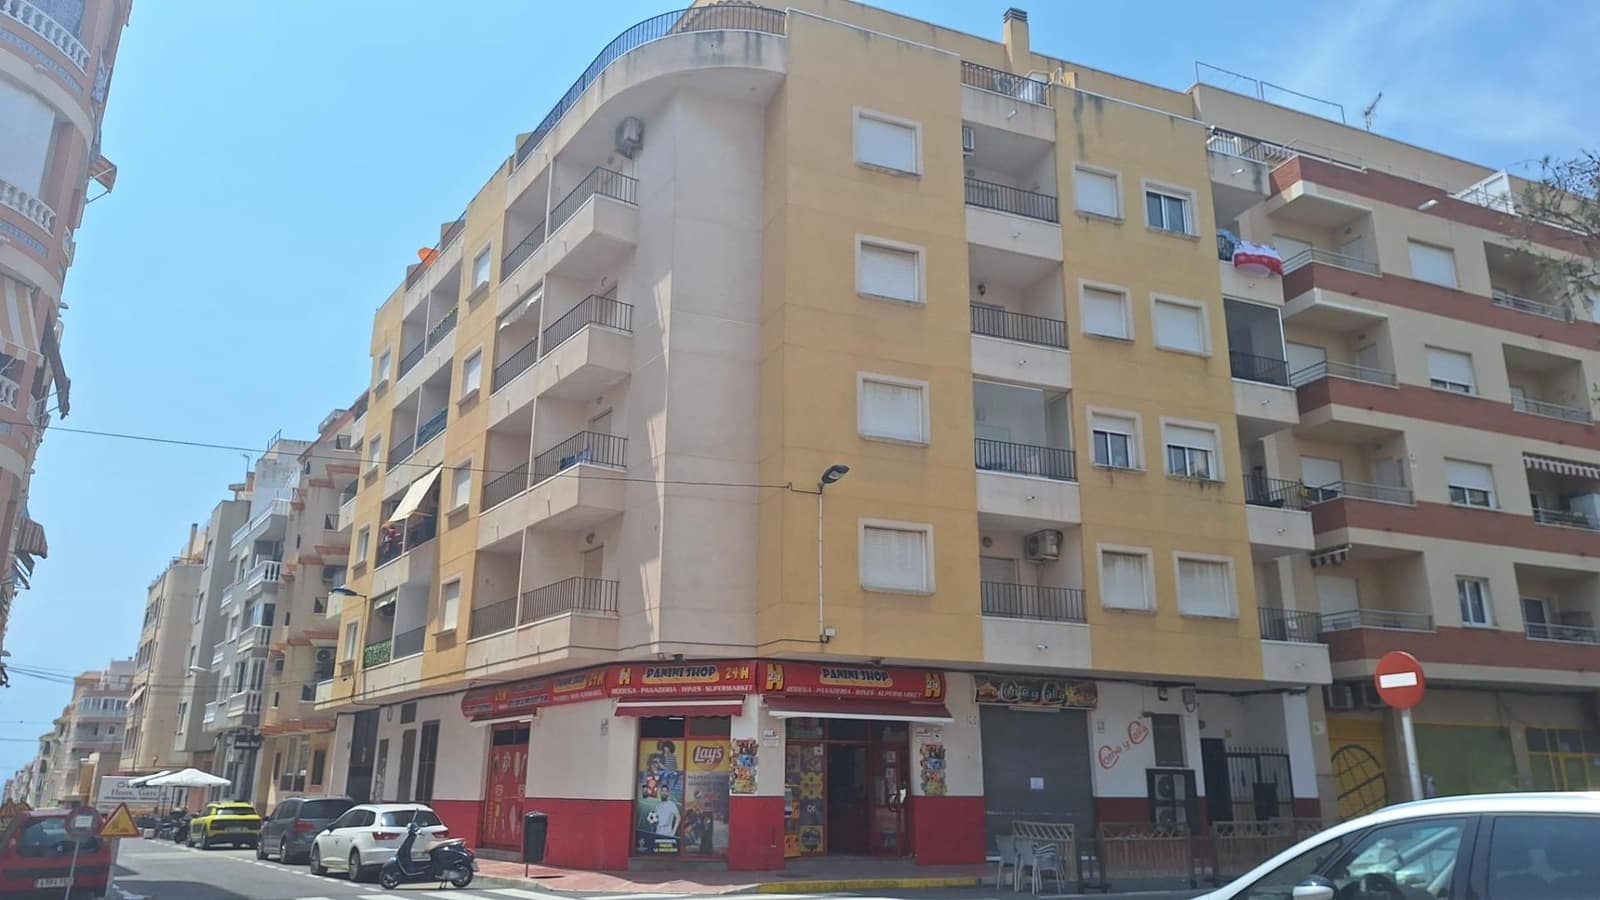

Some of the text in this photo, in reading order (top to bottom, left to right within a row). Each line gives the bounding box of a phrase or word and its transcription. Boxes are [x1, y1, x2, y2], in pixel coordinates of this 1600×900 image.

[646, 667, 682, 678] PANINI
[687, 666, 716, 677] SHOP
[823, 668, 888, 682] PANINI SHOP
[705, 684, 752, 692] SUPERMARKET
[878, 689, 922, 698] SUPERMARKET
[694, 746, 723, 764] Lay's
